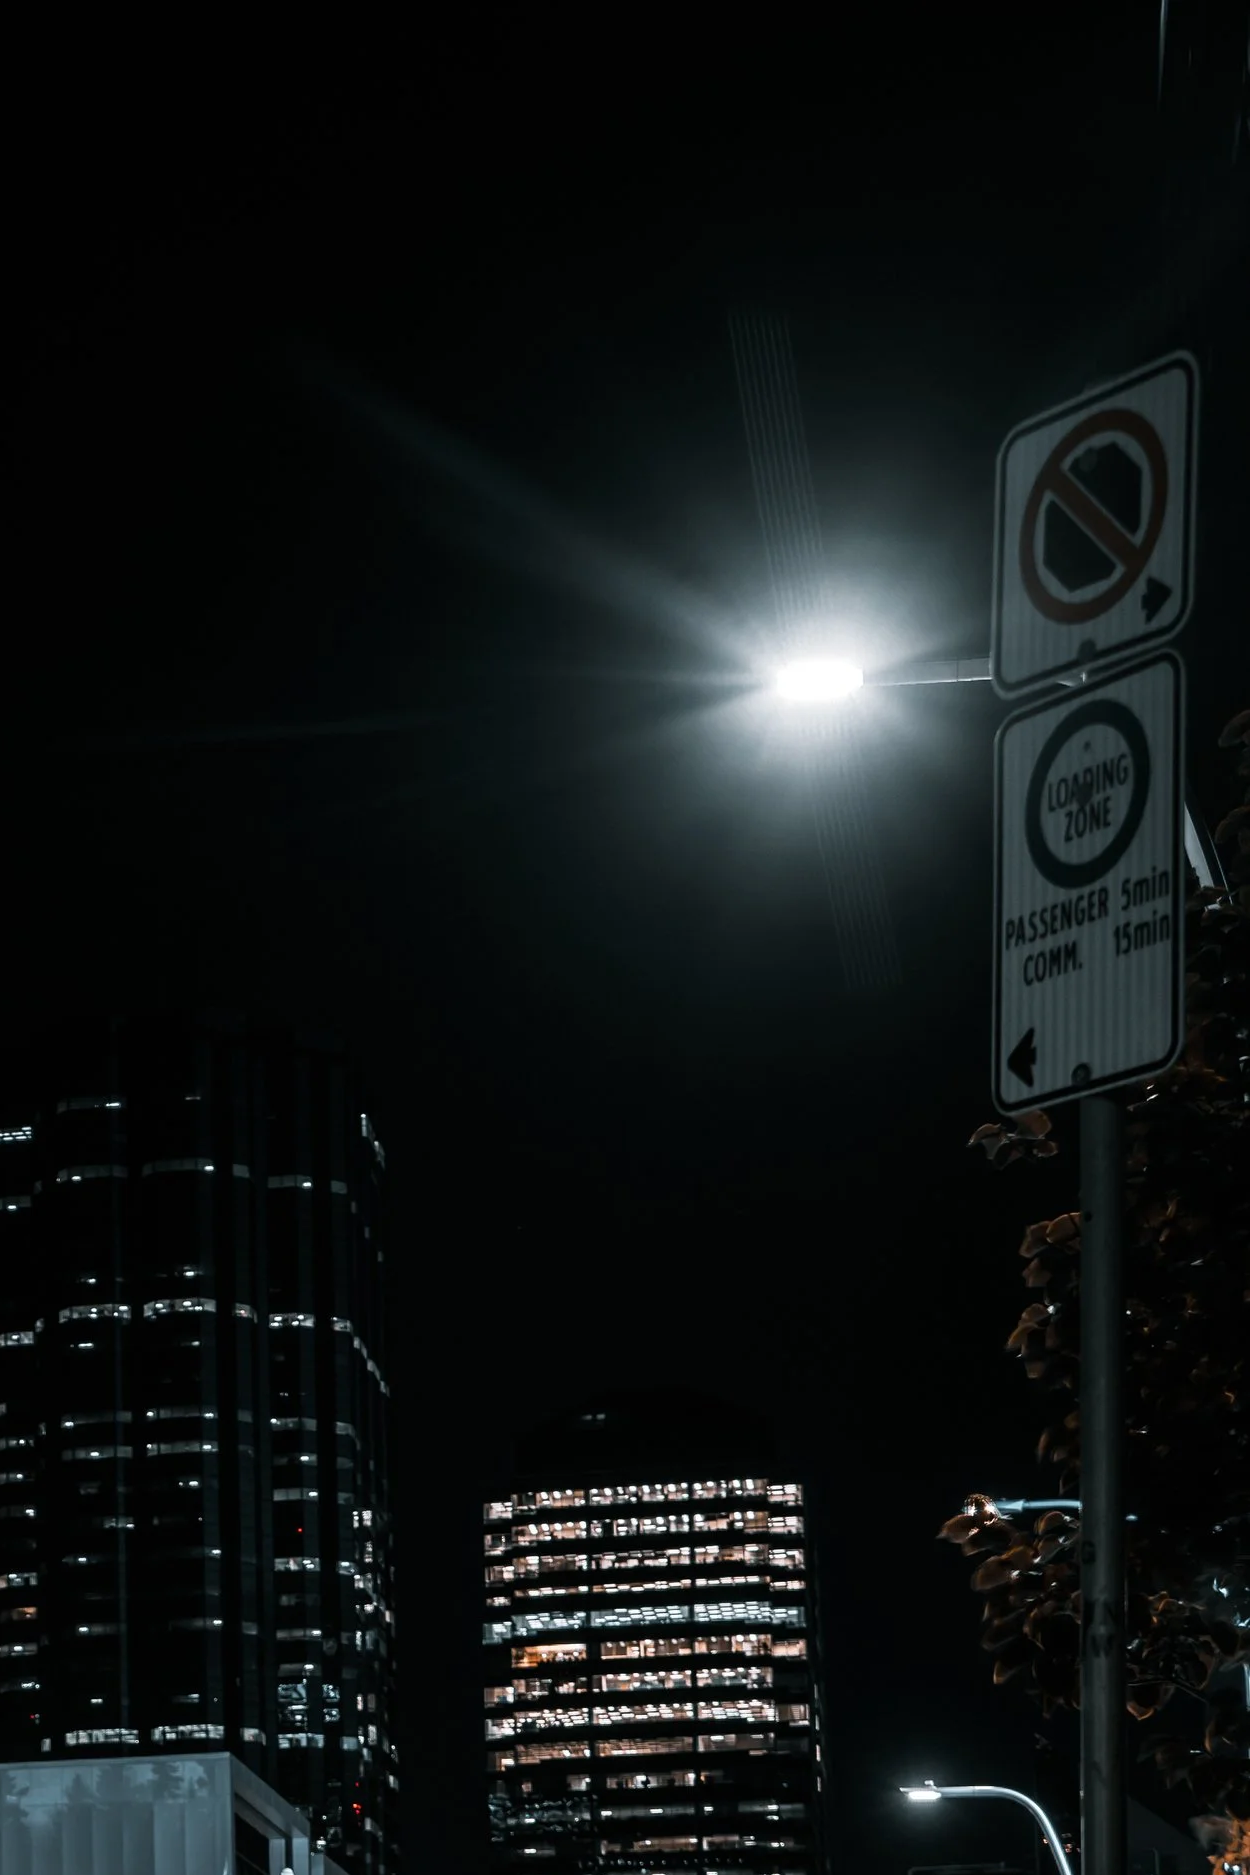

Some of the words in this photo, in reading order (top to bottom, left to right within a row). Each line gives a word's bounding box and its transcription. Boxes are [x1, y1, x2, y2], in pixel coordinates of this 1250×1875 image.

[1047, 753, 1130, 814] LOADING
[1063, 796, 1112, 844] ZONE
[1005, 885, 1110, 951] PASSENGER
[1120, 866, 1171, 912] 5min
[1023, 941, 1084, 987] COMM.
[1112, 912, 1171, 958] 15min
